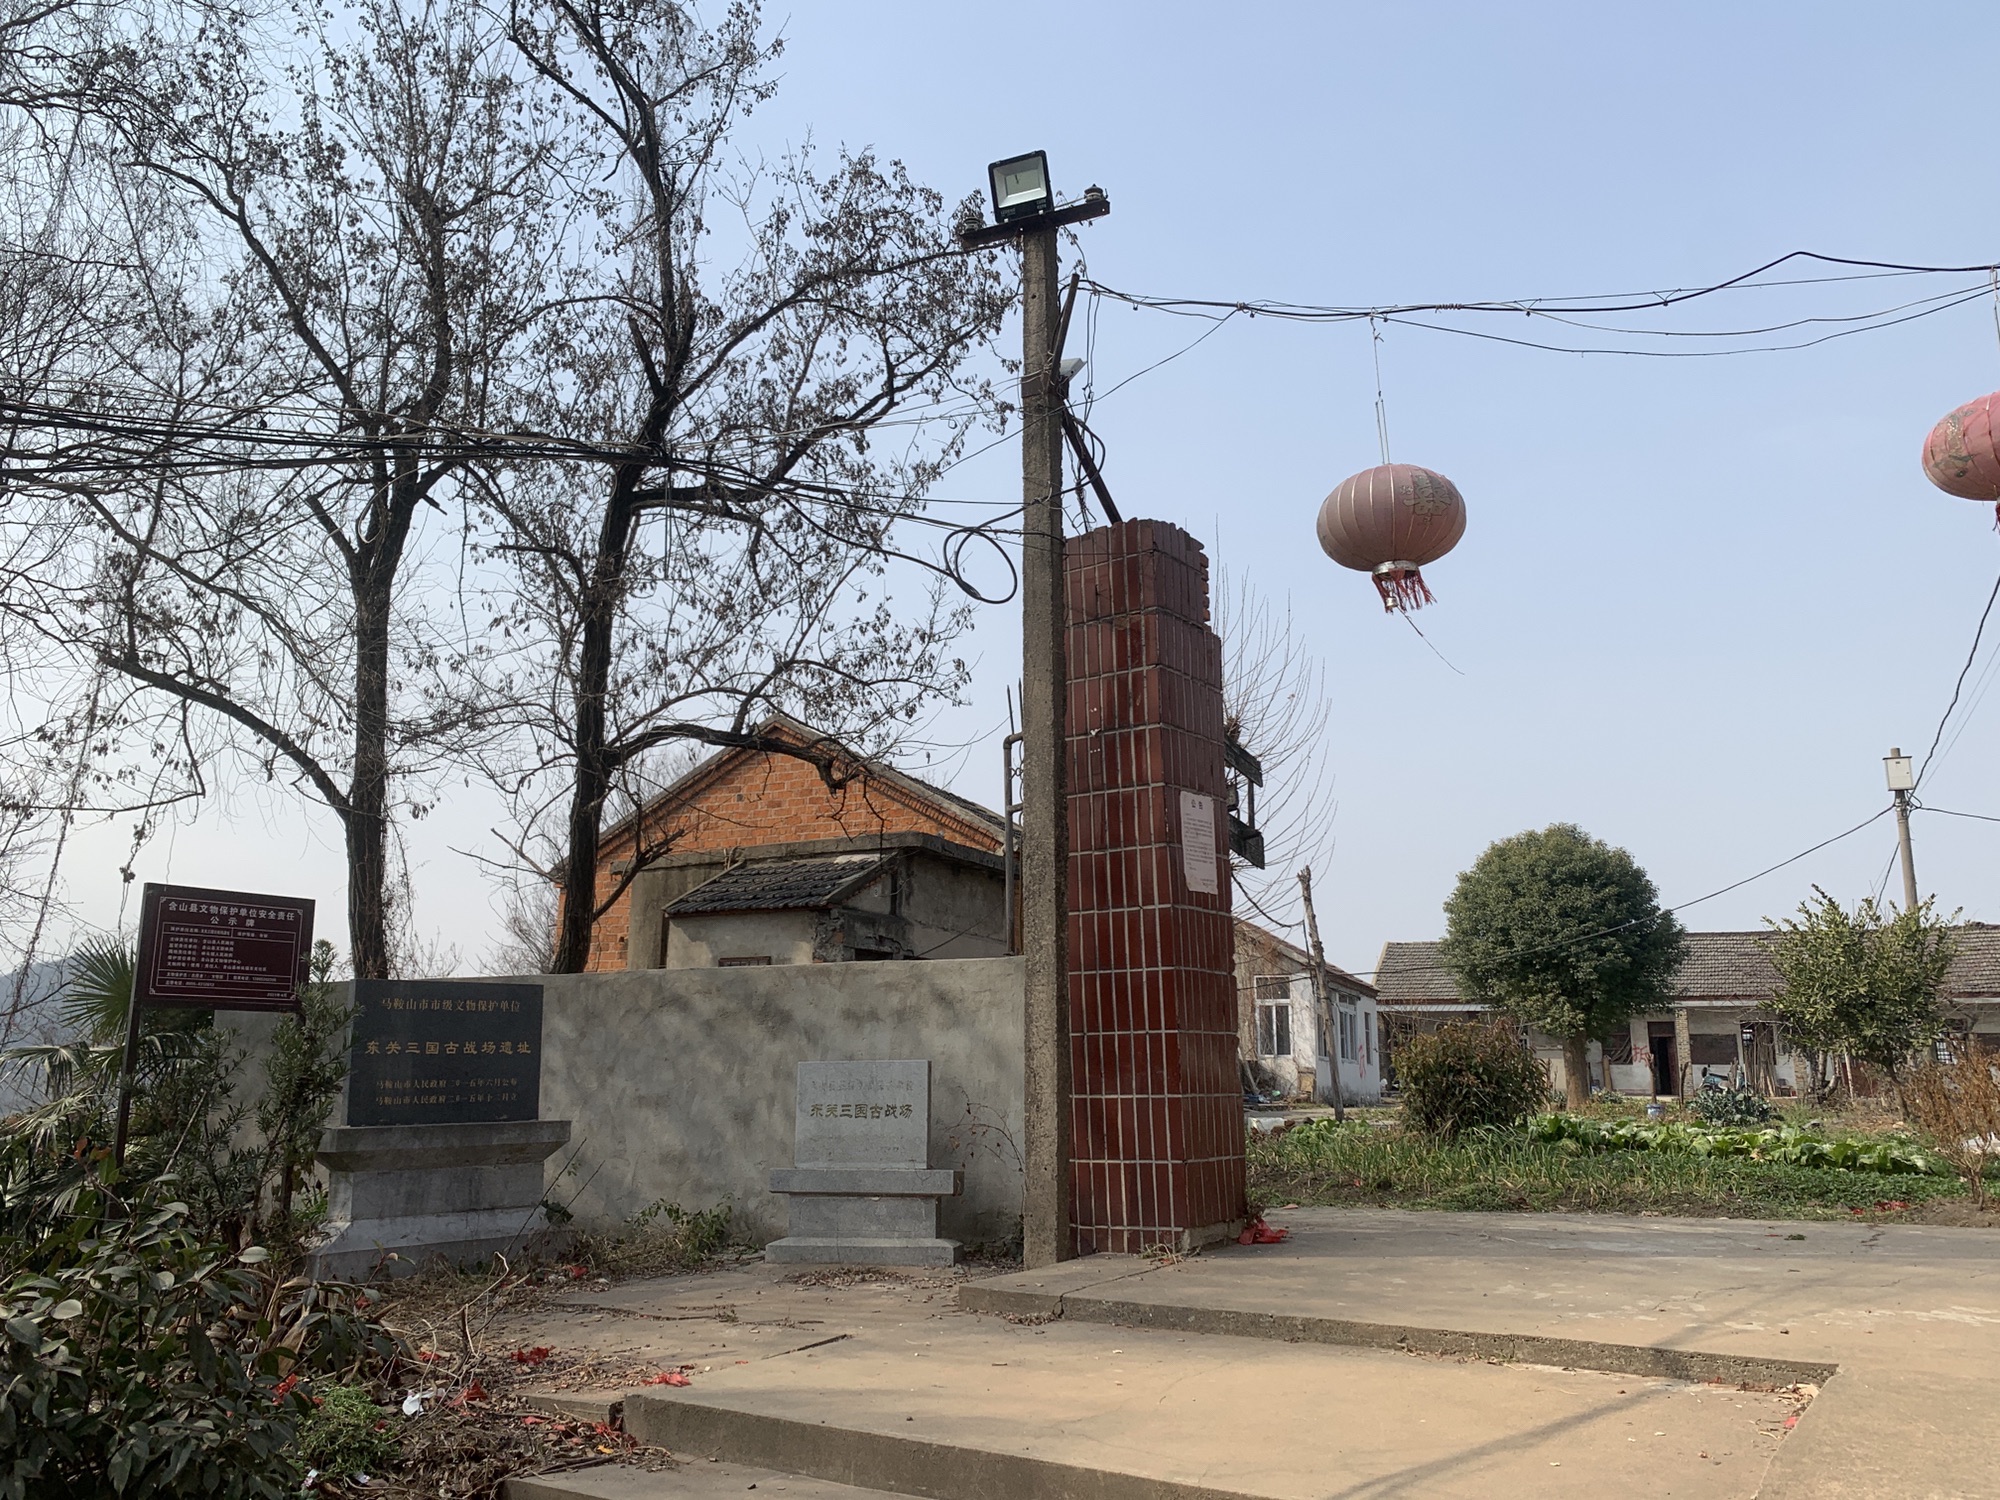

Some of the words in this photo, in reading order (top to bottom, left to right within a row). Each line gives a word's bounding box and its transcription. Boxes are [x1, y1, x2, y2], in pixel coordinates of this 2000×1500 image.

[168, 901, 295, 921] 含山县文物保护单位安全责任
[210, 916, 255, 927] 公示牌
[382, 998, 521, 1013] 马鞍山市市级文物保护单位
[365, 1040, 532, 1055] 东关三国古战场遗址
[810, 1103, 913, 1119] 东关三国古战场
